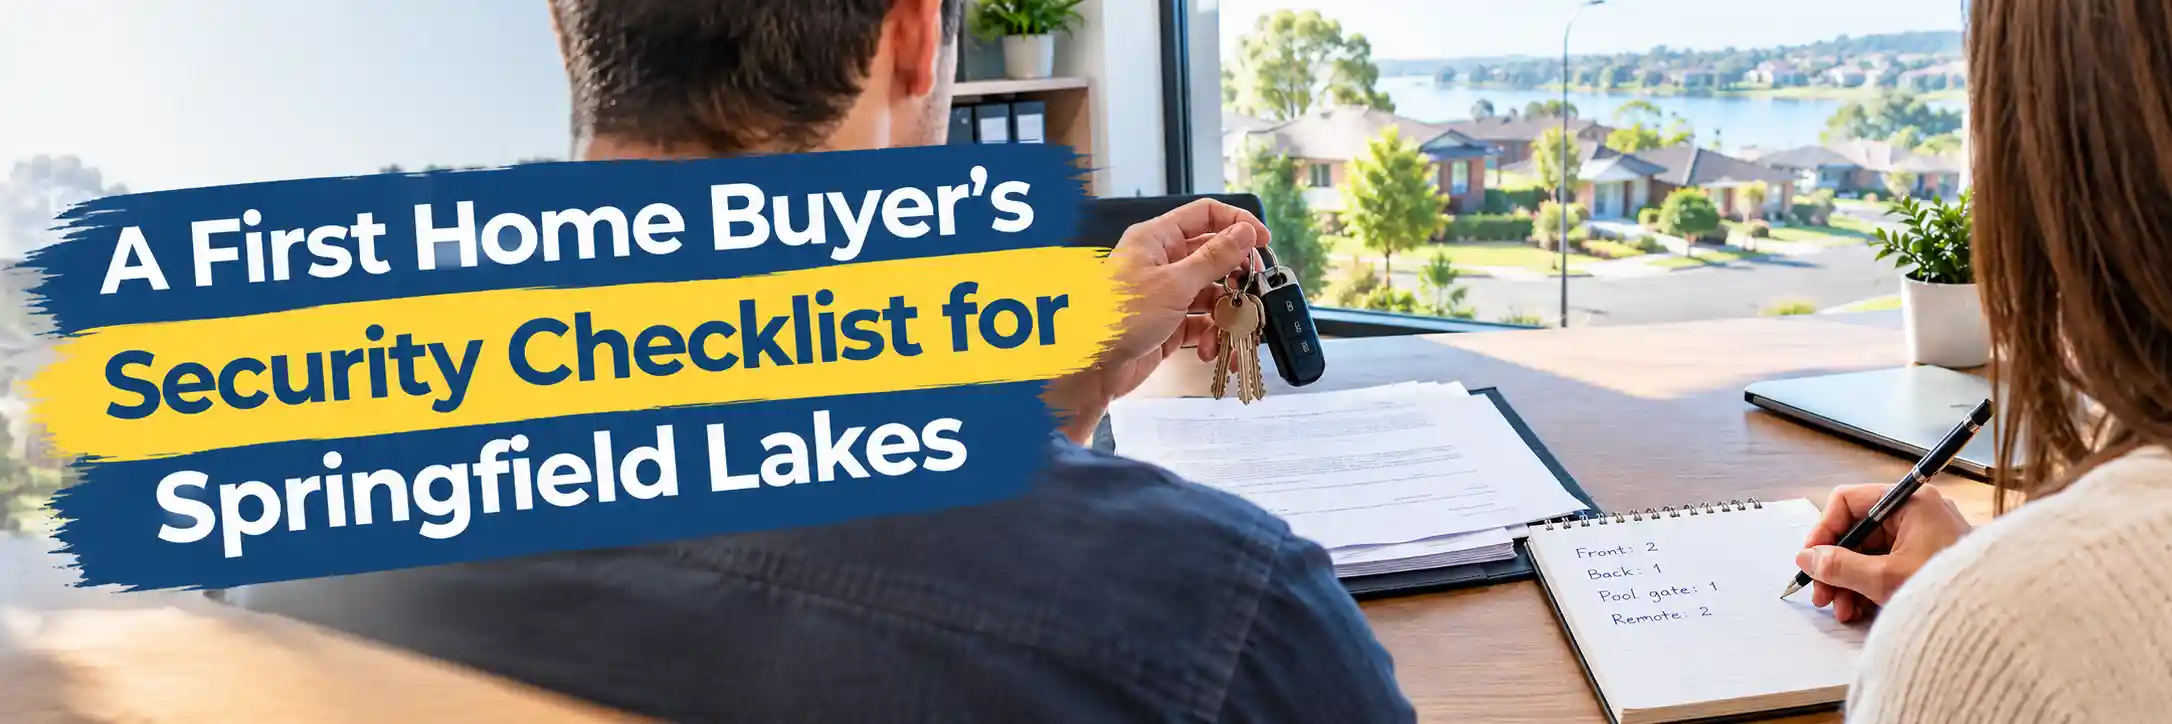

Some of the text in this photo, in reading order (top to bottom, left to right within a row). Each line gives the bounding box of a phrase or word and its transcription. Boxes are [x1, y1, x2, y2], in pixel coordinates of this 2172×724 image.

[1576, 541, 1658, 559] Front: 2
[1587, 563, 1662, 580] Back: 1
[1598, 581, 1718, 603] Pool gate: 1
[1611, 606, 1712, 626] Remote: 2
